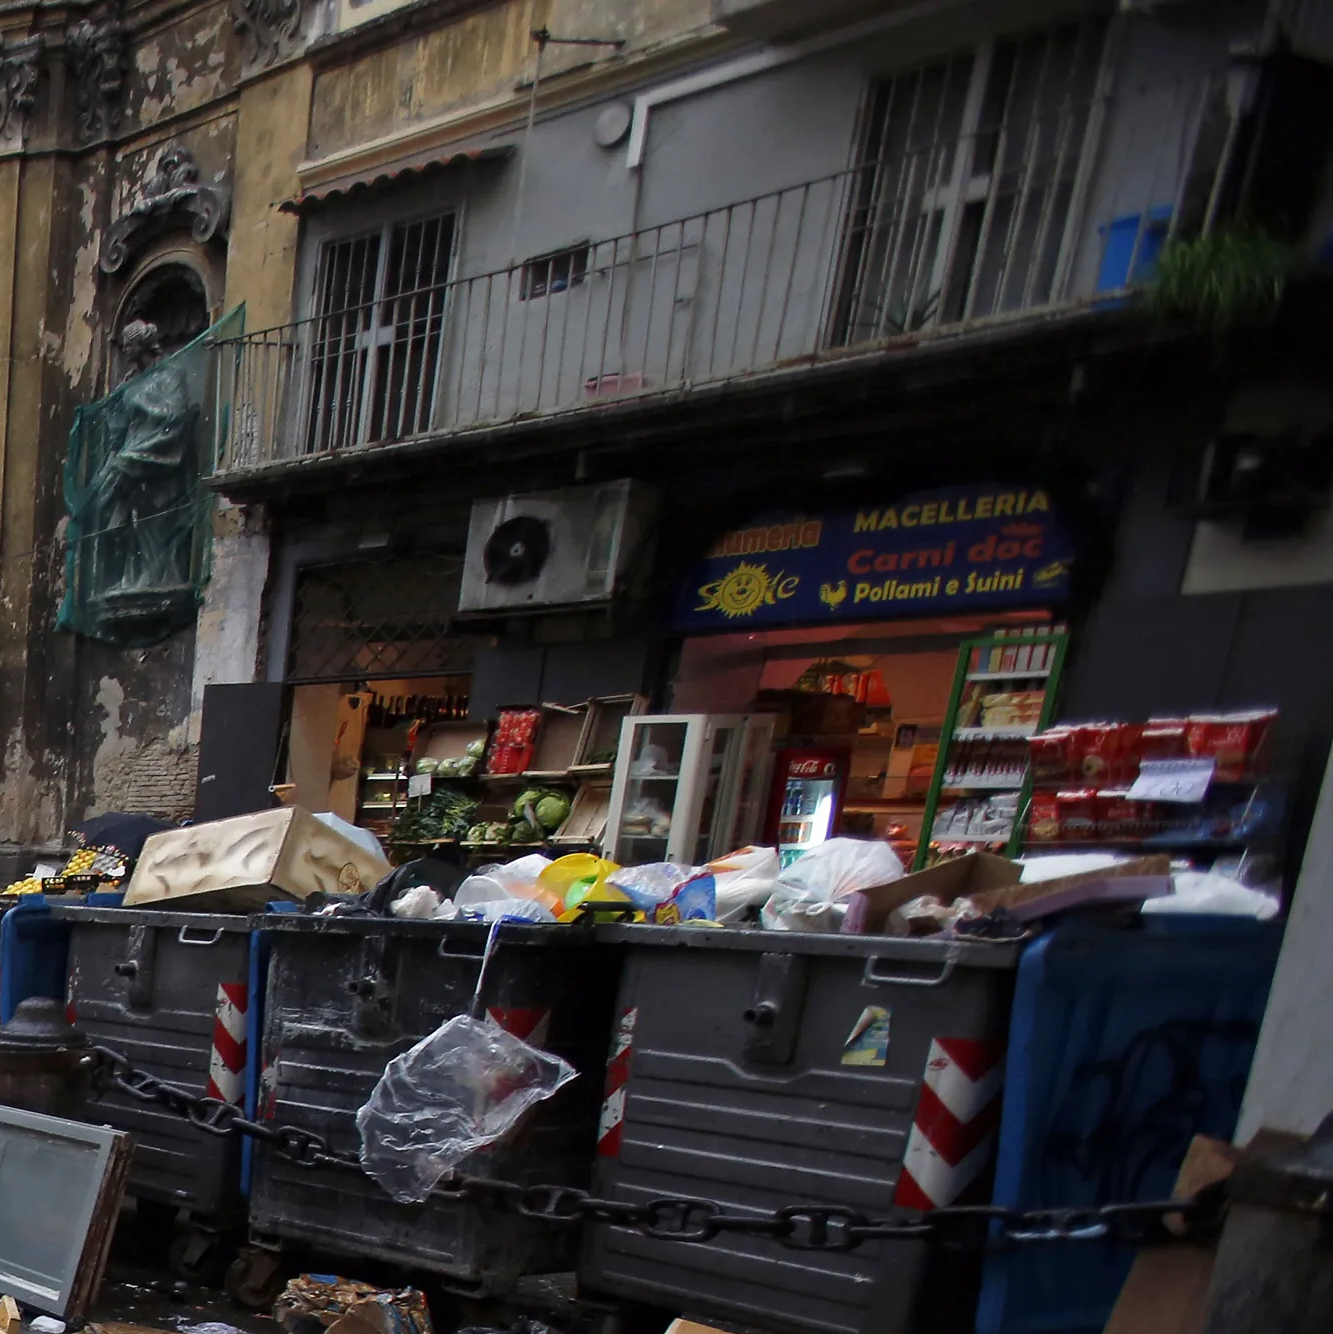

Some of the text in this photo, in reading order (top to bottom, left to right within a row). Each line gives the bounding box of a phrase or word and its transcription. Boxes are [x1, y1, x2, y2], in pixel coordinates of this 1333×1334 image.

[853, 490, 1049, 533] MACELLERIA
[847, 535, 1042, 575] Carni doc
[853, 568, 1024, 603] Pollami e Suini
